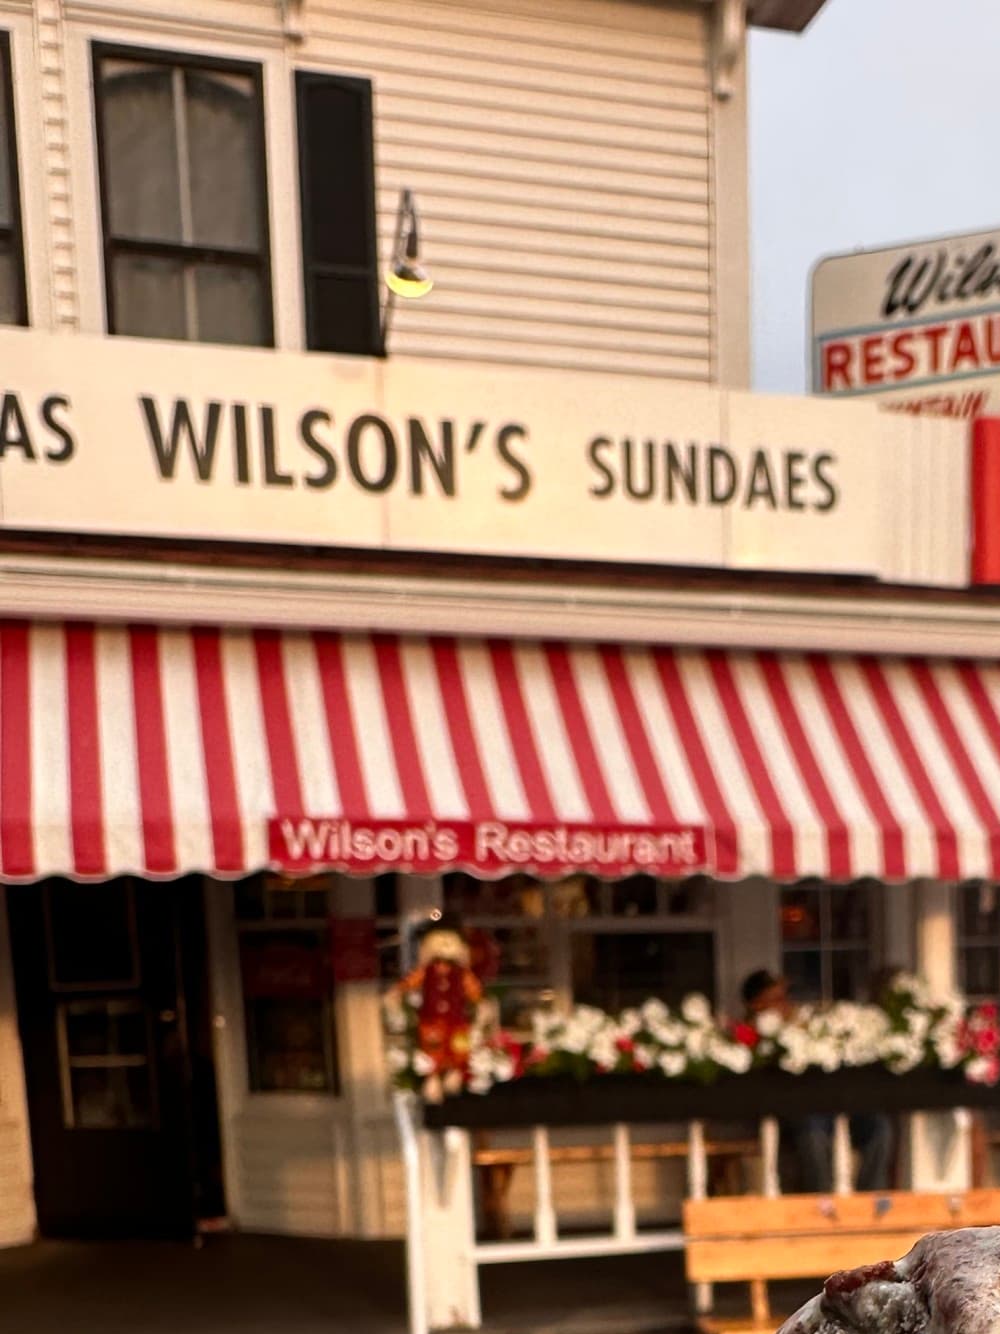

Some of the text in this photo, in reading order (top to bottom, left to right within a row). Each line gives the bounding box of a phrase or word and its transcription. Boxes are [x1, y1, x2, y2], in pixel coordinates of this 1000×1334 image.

[138, 393, 532, 502] WILSON'S
[588, 436, 838, 512] SUNDAES
[280, 817, 697, 865] Wilson's Restaurant
